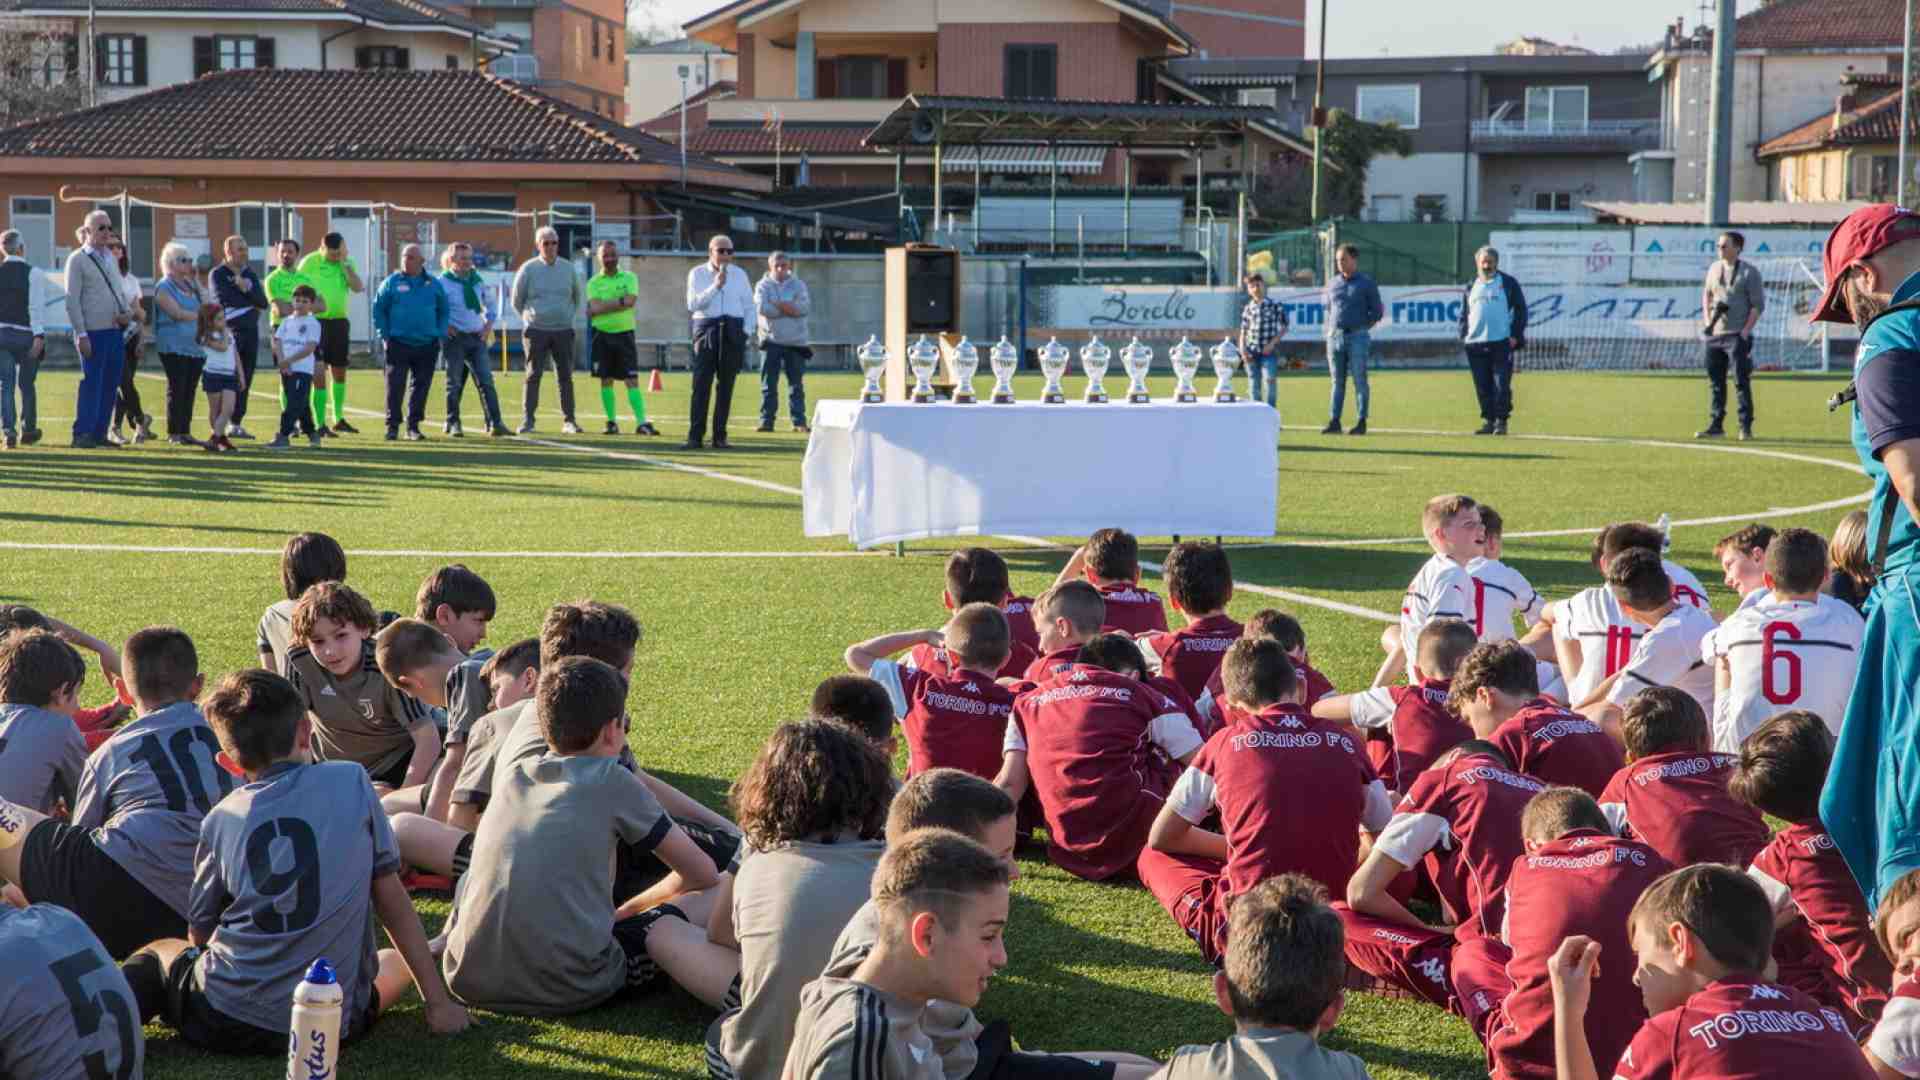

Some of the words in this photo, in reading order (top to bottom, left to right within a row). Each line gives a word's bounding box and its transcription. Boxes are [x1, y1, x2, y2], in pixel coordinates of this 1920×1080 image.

[1088, 288, 1197, 326] Borello
[1284, 302, 1325, 325] rim
[1762, 620, 1802, 705] 6
[927, 691, 986, 715] TORINO
[1231, 731, 1321, 751] TORINO
[1325, 731, 1354, 752] FC
[128, 725, 233, 816] 10
[1633, 757, 1711, 787] TORINO
[246, 816, 321, 934] 9
[1615, 847, 1647, 867] FC
[49, 948, 136, 1080] 5
[1689, 1010, 1824, 1050] TORINO
